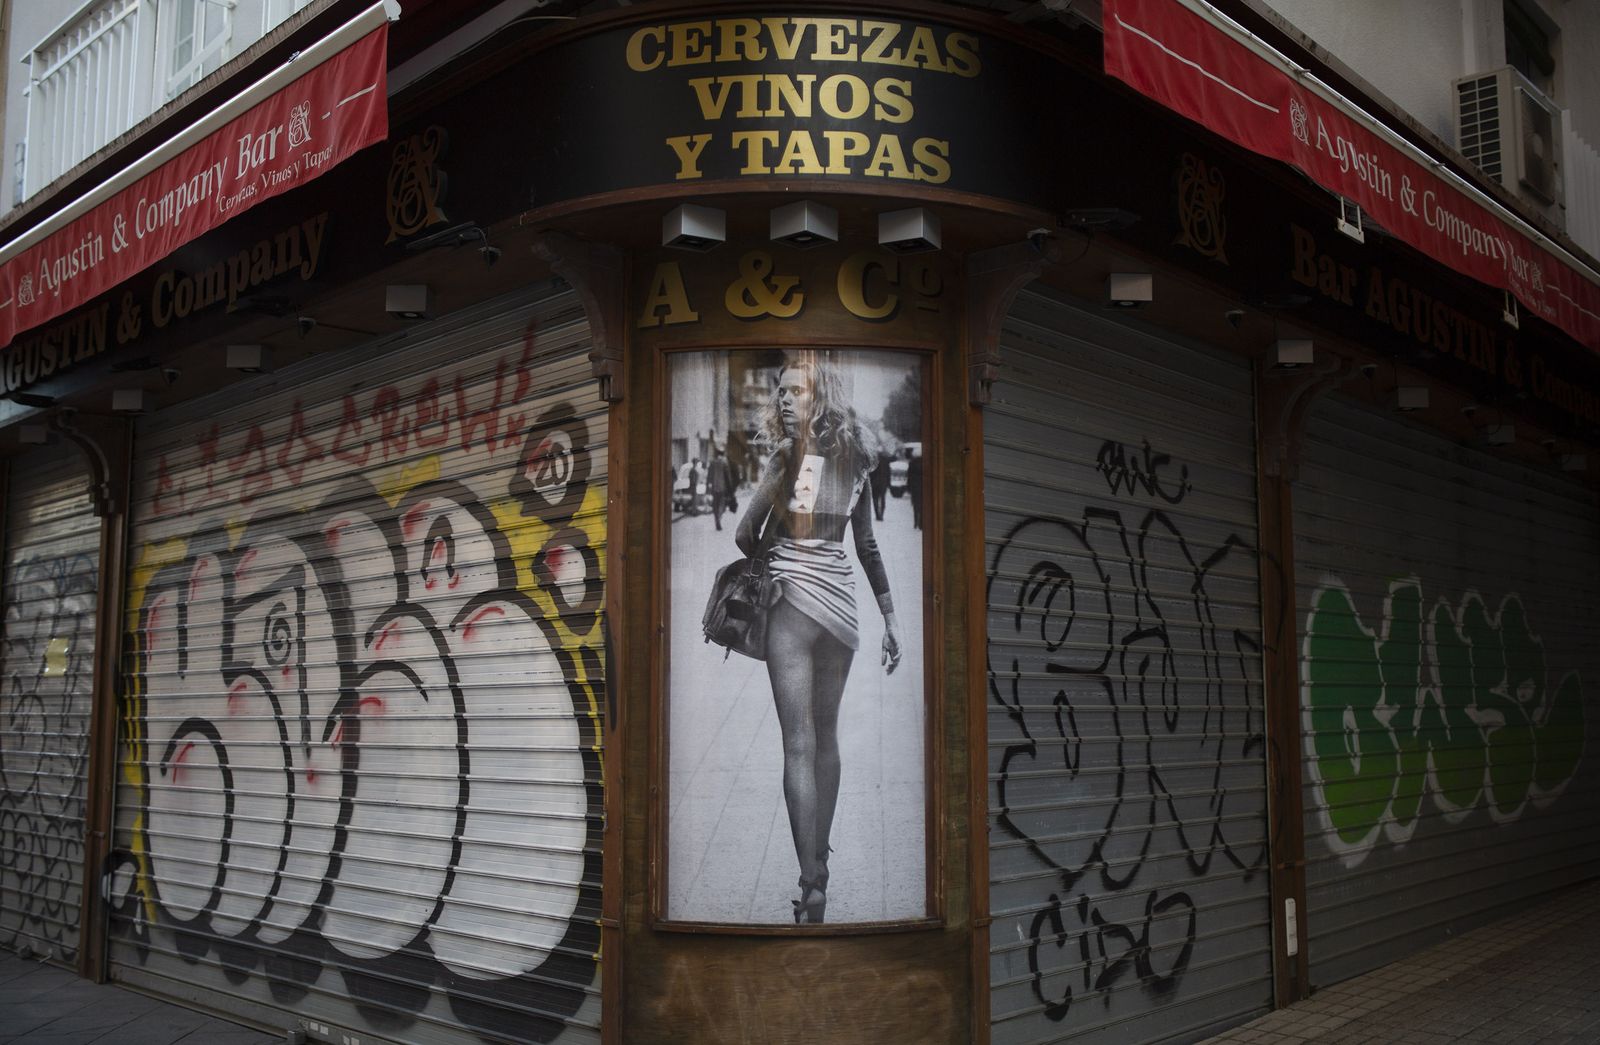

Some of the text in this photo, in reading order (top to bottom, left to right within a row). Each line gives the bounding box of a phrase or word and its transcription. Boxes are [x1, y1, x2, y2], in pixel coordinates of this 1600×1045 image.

[626, 17, 982, 78] CERVEZAS
[688, 74, 915, 124] VINOS
[261, 165, 291, 188] Vinos
[666, 130, 952, 185] Y TAPAS
[1315, 115, 1394, 202] Agustin
[1400, 175, 1419, 217] &
[1423, 190, 1507, 271] Company
[38, 124, 284, 296] Agustin & Company Bar
[116, 290, 142, 344] &
[151, 208, 329, 328] Company
[637, 262, 699, 328] A
[724, 251, 806, 319] &
[1290, 221, 1358, 306] Bar
[1364, 266, 1498, 376] AGUSTIN
